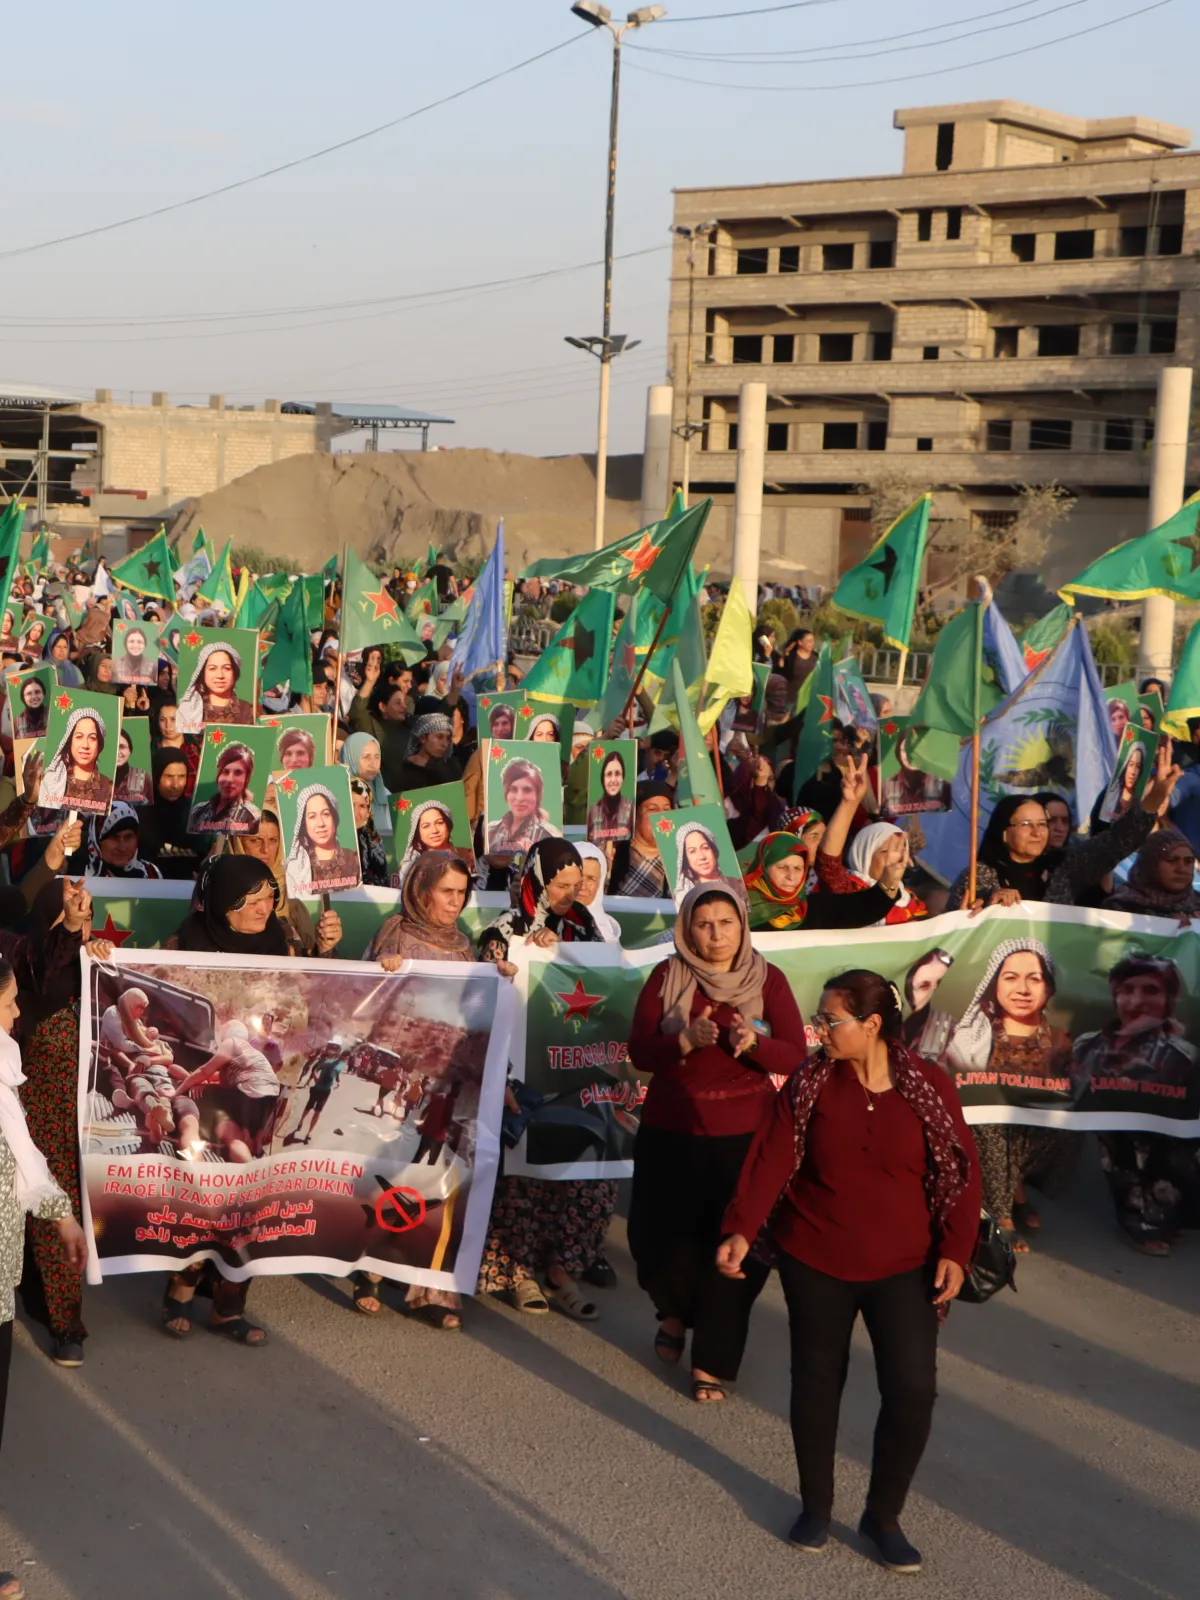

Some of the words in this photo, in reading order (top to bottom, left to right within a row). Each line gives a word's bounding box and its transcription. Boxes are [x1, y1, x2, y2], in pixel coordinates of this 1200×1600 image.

[608, 1040, 631, 1062] DE
[1000, 1073, 1072, 1091] TOLHILDAN
[107, 1164, 133, 1179] EM
[199, 1169, 259, 1189] HOVANE
[273, 1160, 298, 1177] SER
[300, 1157, 364, 1179] SIVÎLÊN
[104, 1180, 157, 1199] IRAQÊ
[161, 1183, 176, 1198] LI
[179, 1187, 225, 1207] ZAXO
[306, 1177, 355, 1197] DIKIN
[146, 1204, 177, 1225] على
[280, 1199, 314, 1218] ندين
[135, 1225, 170, 1242] زاخو
[172, 1231, 199, 1249] في
[257, 1218, 317, 1242] المدنيين
